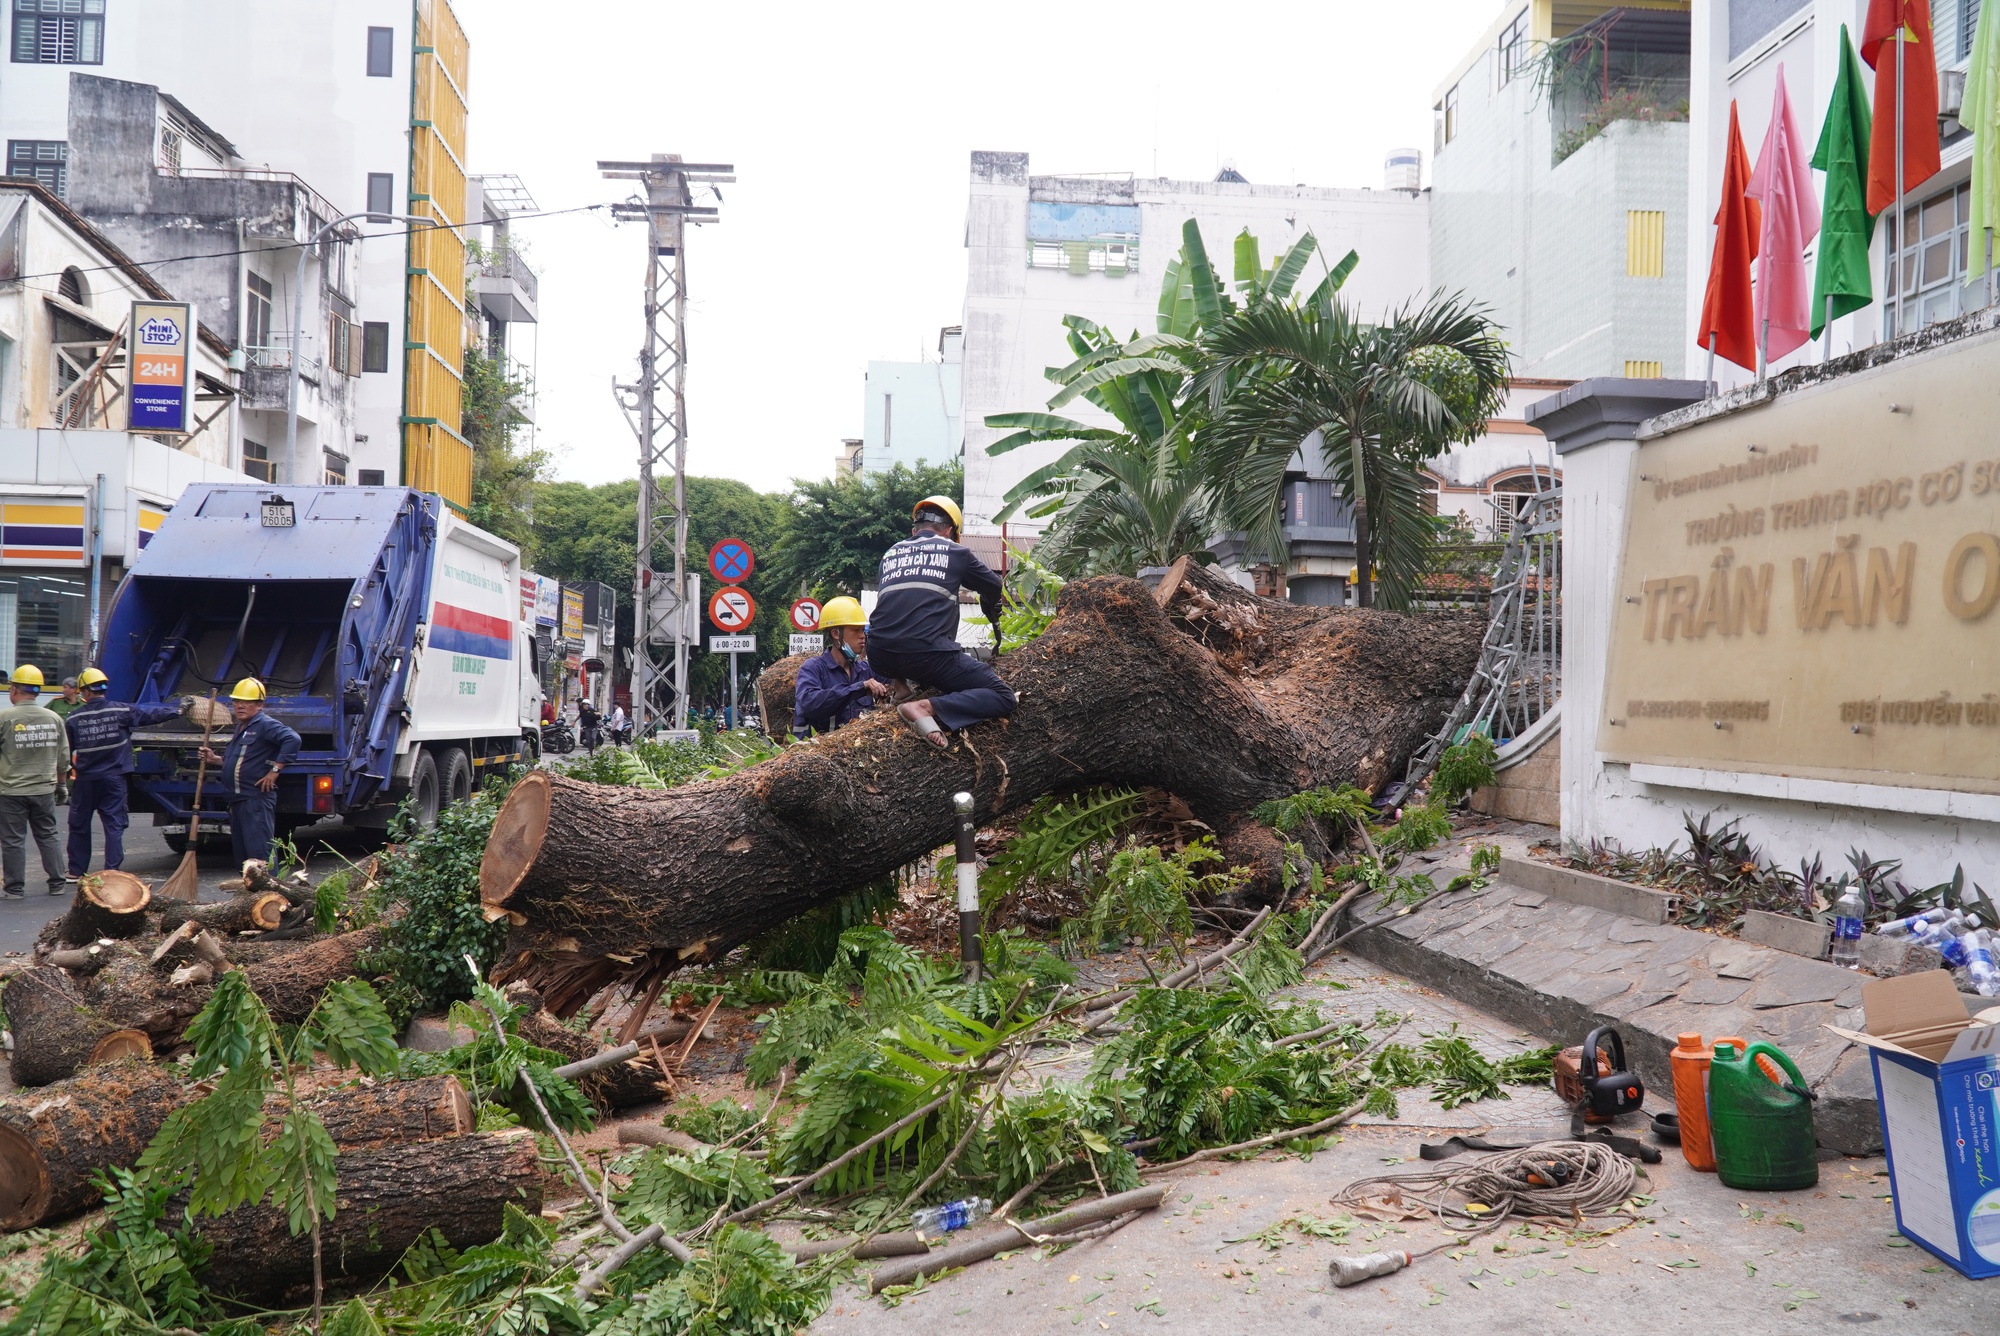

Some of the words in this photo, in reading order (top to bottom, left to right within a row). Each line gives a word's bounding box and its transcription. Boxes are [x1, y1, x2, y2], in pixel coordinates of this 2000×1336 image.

[148, 324, 172, 333] MINI
[147, 333, 173, 342] STOP
[140, 361, 177, 377] 24H
[134, 397, 180, 406] CONVENIENCE
[269, 506, 285, 516] 51C
[1770, 489, 1849, 531] TRUNG
[1853, 477, 1913, 521] HỌC
[263, 516, 292, 526] 760.05
[897, 546, 911, 555] CÔNG
[920, 543, 936, 551] TNHH
[882, 557, 897, 574] CÔNG
[897, 554, 913, 568] VIÊN
[914, 552, 929, 566] CÂY
[929, 554, 949, 568] XANH
[904, 567, 920, 577] CHÍ
[922, 568, 946, 580] MINH
[1641, 546, 1775, 644] TRẦN
[1792, 533, 1917, 633] VĂN
[1977, 1105, 1987, 1123] Chai
[1971, 1127, 1979, 1146] thêm
[1974, 1147, 1994, 1188] xanh
